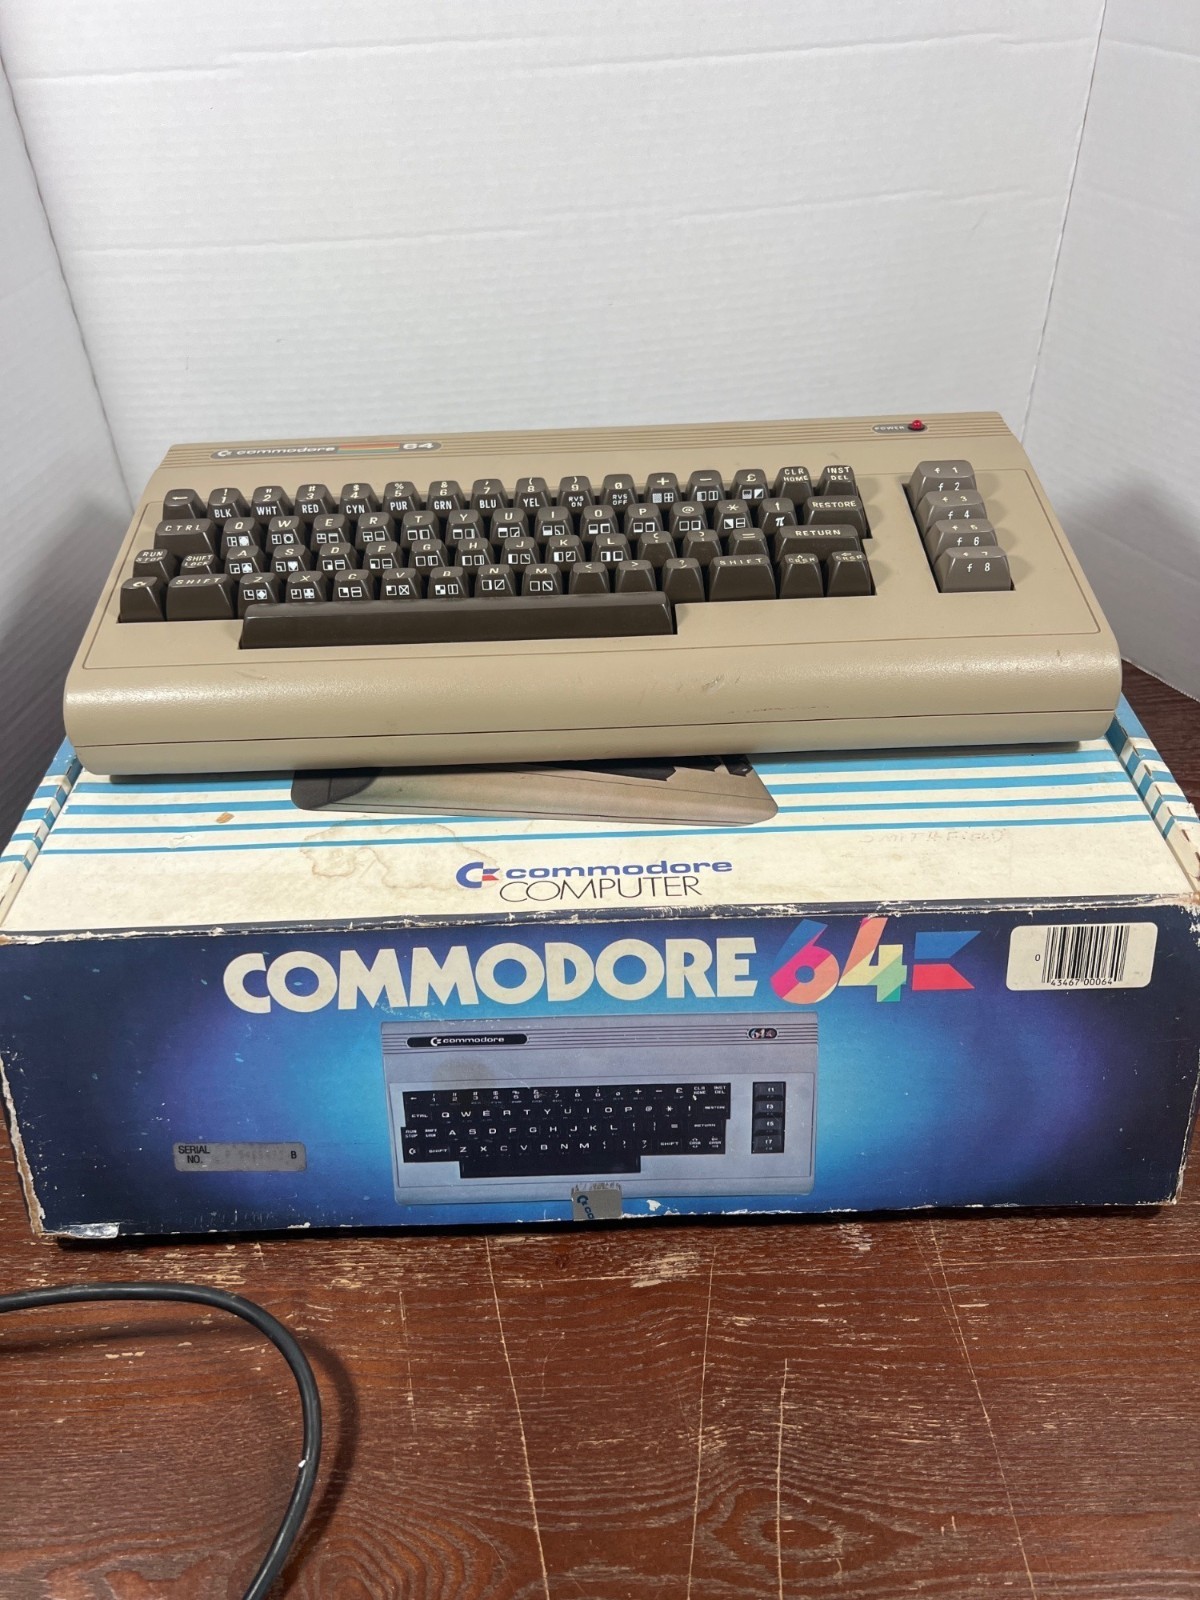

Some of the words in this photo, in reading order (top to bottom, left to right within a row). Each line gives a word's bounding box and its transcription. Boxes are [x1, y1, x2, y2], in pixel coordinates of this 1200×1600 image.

[236, 445, 336, 456] commodore
[403, 442, 434, 450] 64
[784, 467, 805, 475] CLR
[827, 466, 850, 474] INST
[390, 501, 408, 511] PUR
[434, 500, 452, 510] GRN
[479, 499, 496, 509] BLU
[523, 498, 540, 507] YEL
[812, 500, 857, 509] RESTORE
[214, 509, 232, 518] BLK
[256, 506, 278, 516] WHT
[302, 504, 319, 514] RED
[346, 505, 365, 514] CYN
[594, 509, 603, 517] O
[682, 505, 695, 513] @
[460, 513, 468, 522] Y
[505, 512, 513, 520] U
[278, 520, 292, 528] W
[325, 519, 333, 527] E
[369, 517, 378, 525] R
[795, 529, 841, 537] RETURN
[185, 554, 214, 562] SHIFT
[720, 557, 763, 566] SHIFT
[175, 577, 222, 585] SHIFT
[505, 860, 733, 879] commodore
[499, 876, 702, 902] COMPUTER
[222, 936, 758, 1014] COMMODORE
[769, 917, 907, 1004] 64
[1050, 978, 1080, 987] 43467
[1083, 978, 1113, 986] 00064
[443, 1036, 505, 1044] commodore
[178, 1145, 210, 1154] SERIAL
[187, 1155, 203, 1164] NO.
